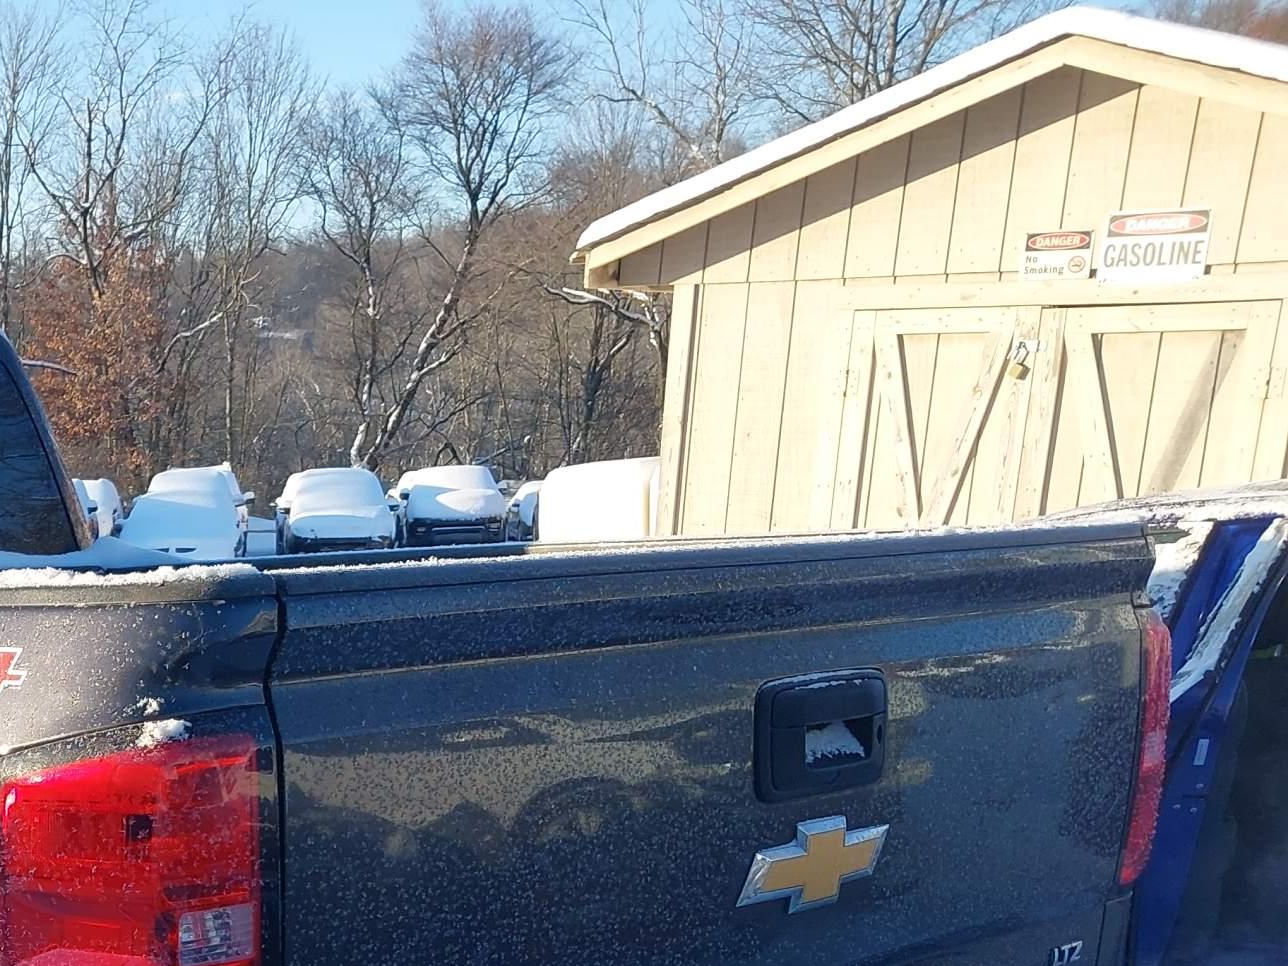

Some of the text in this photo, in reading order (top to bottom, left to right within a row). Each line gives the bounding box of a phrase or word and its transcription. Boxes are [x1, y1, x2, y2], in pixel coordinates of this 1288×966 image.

[1035, 236, 1081, 248] DANGER
[1025, 255, 1038, 264] No
[1103, 240, 1206, 268] GASOLINE
[1023, 265, 1064, 276] Smoking
